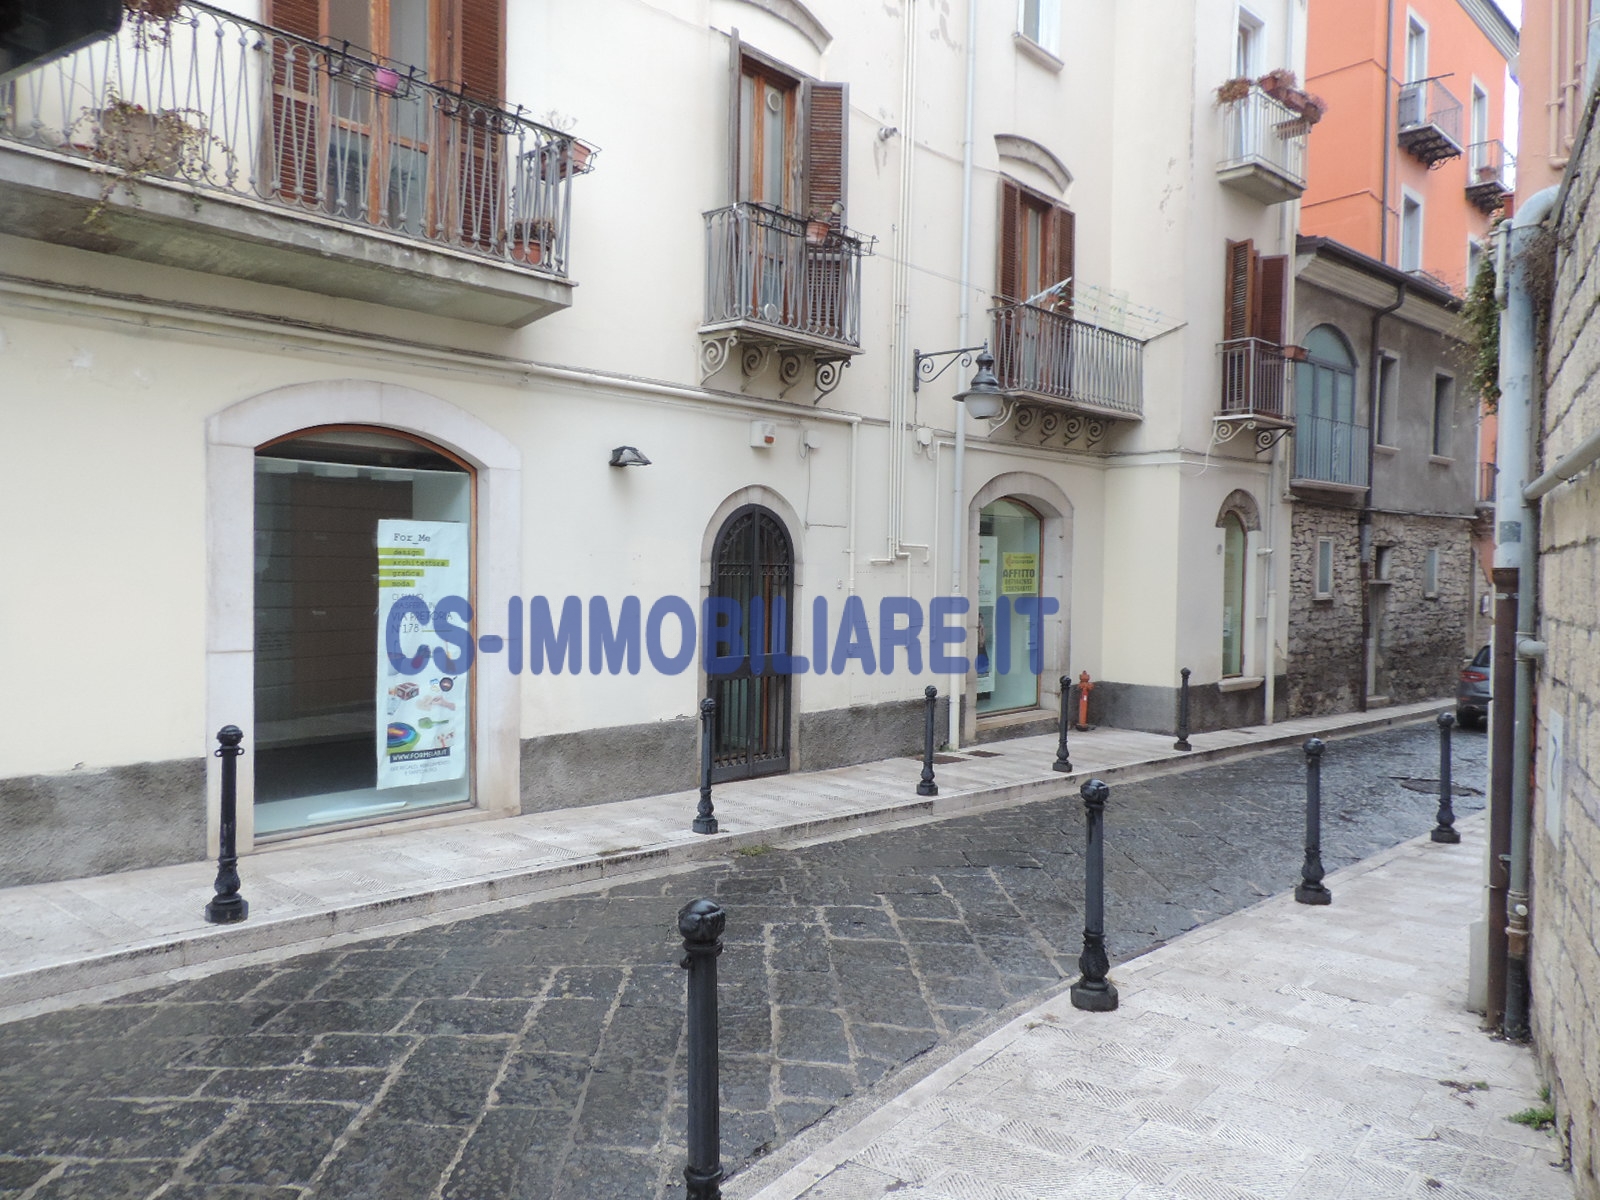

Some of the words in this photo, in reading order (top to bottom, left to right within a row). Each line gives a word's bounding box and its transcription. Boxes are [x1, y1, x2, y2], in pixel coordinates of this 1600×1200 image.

[393, 533, 431, 545] For_Me
[392, 570, 420, 578] grafica
[1003, 569, 1035, 578] AFFITTO
